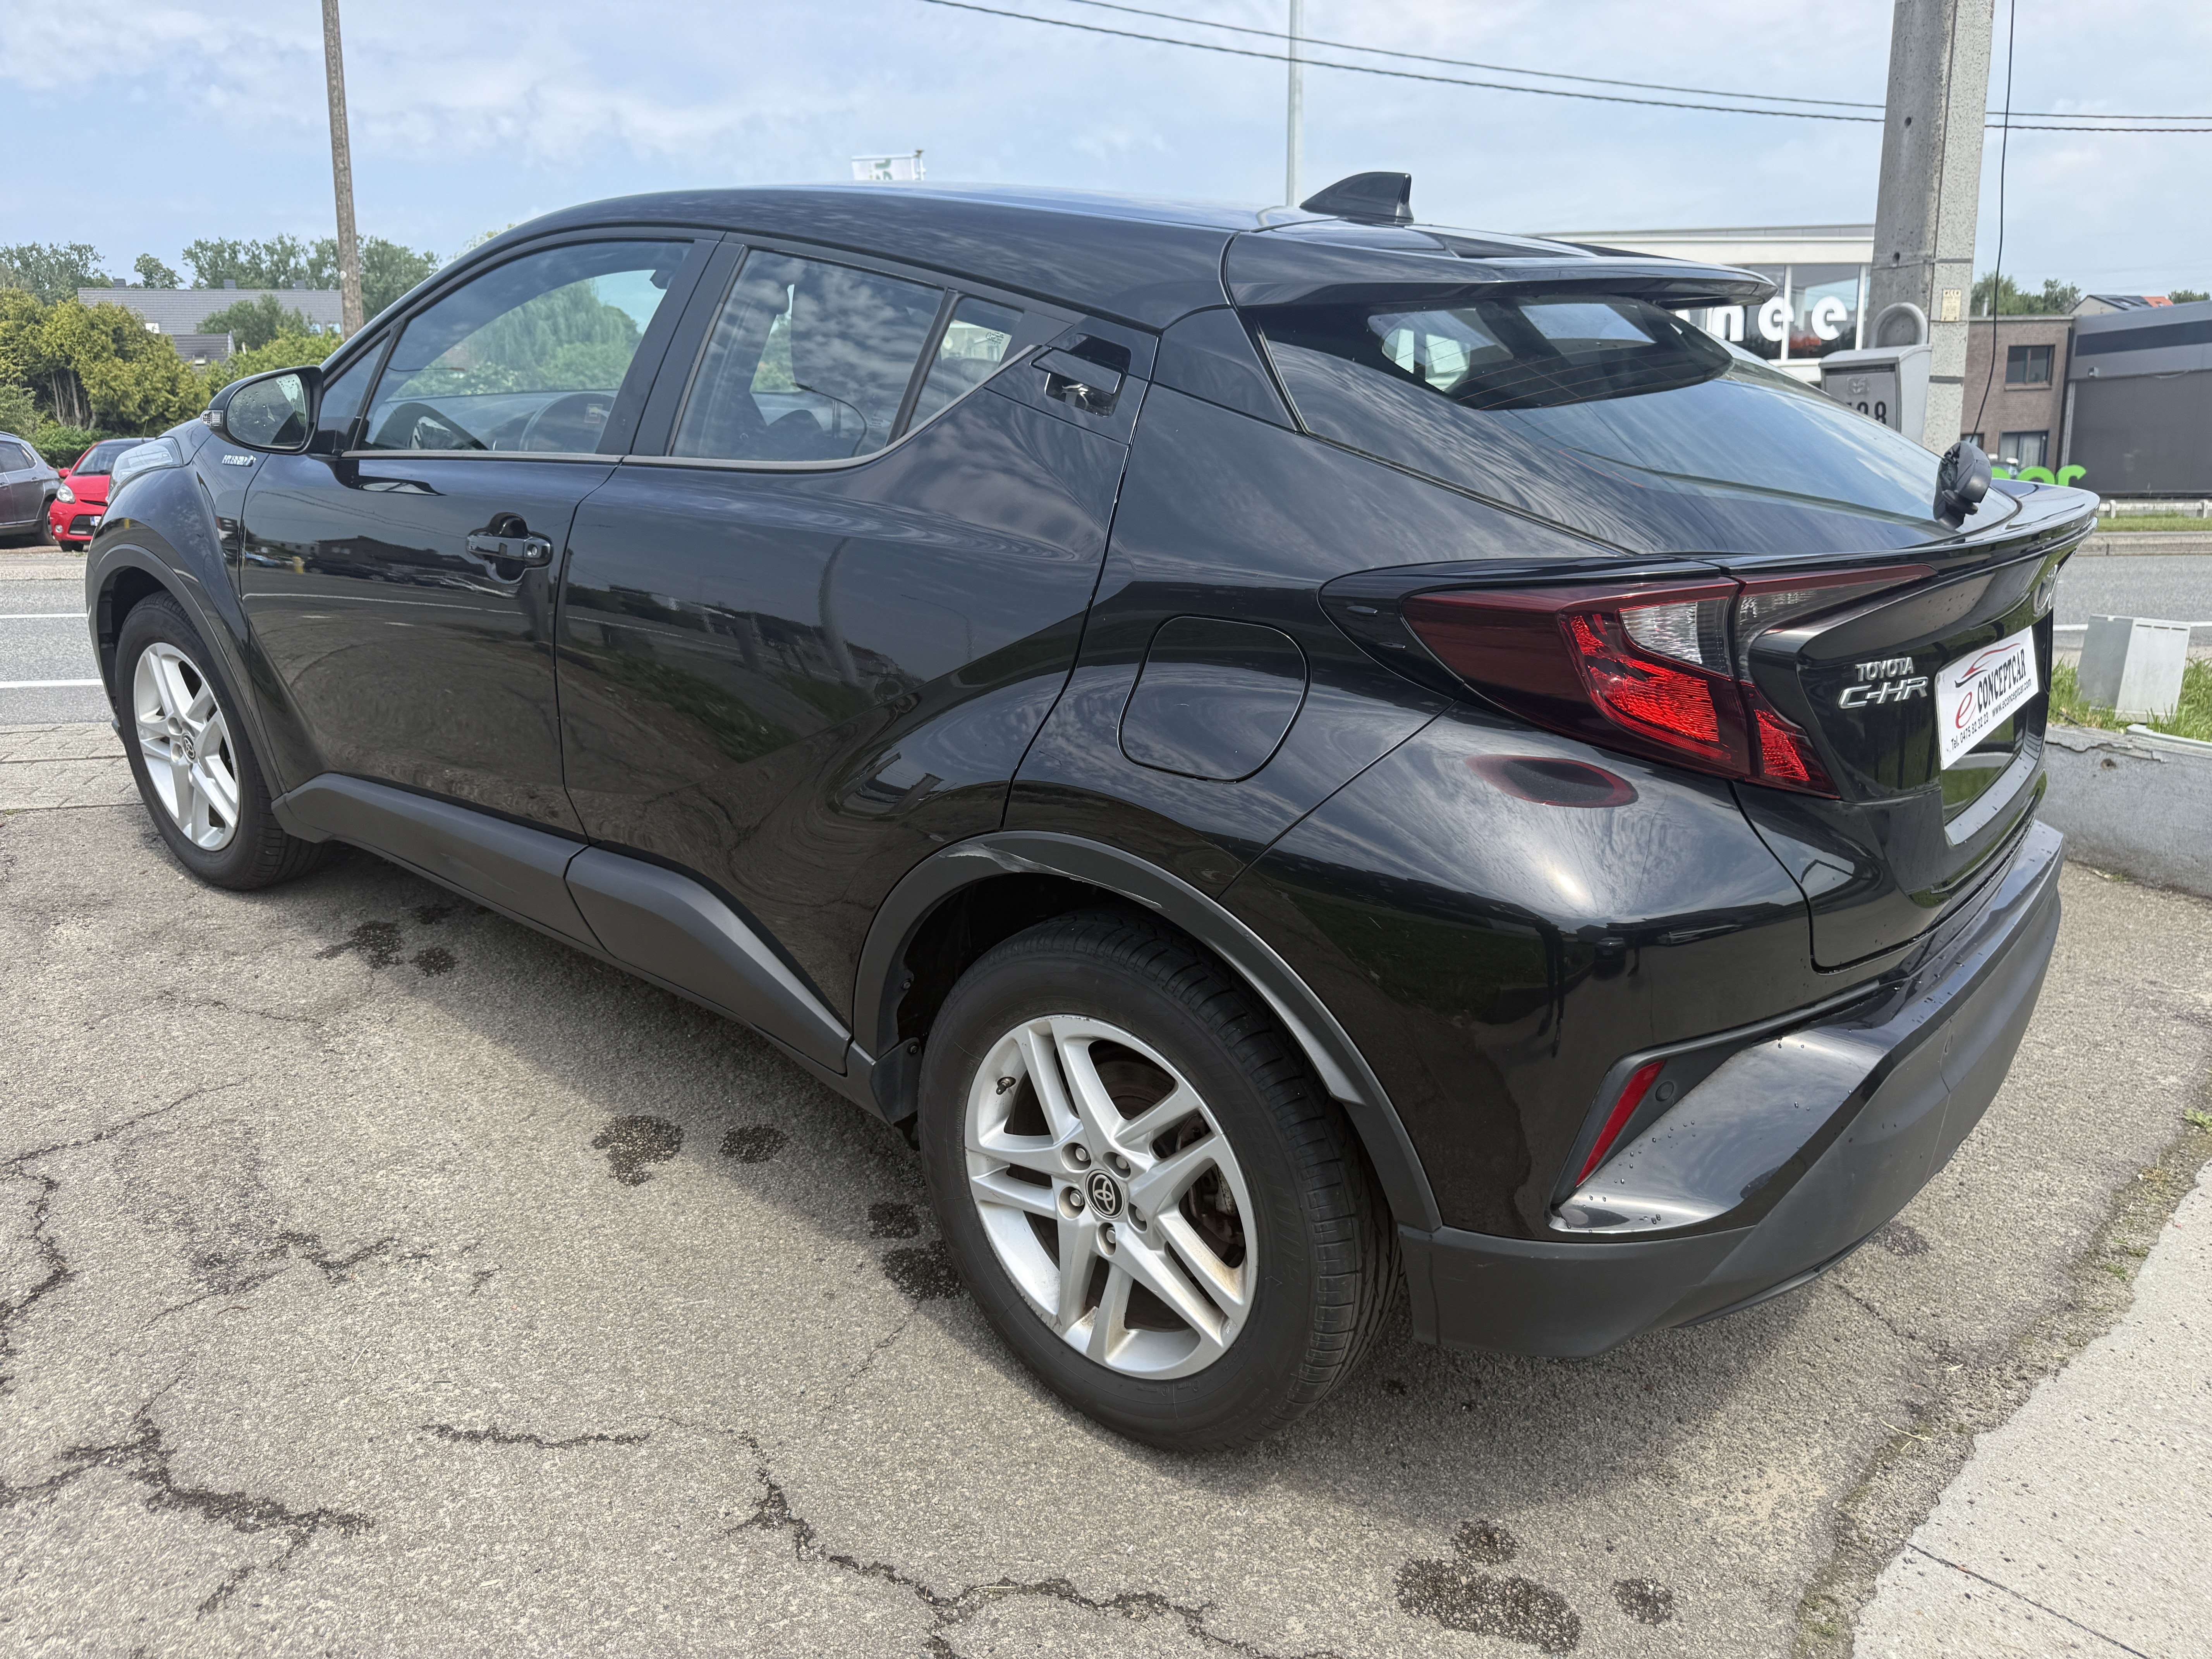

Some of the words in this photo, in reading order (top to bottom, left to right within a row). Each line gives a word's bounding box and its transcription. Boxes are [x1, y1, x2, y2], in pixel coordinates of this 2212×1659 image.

[1675, 295, 1847, 341] nee
[1838, 676, 1929, 709] C-HR
[1855, 657, 1914, 682] TOYOTA
[1977, 648, 2026, 713] CONCEPTCAR
[1951, 737, 1959, 750] Tel.
[1960, 727, 1971, 743] 0475
[1972, 722, 1977, 735] 82
[1978, 717, 1984, 730] 32
[1984, 712, 1989, 725] 23
[1992, 678, 2032, 717] www.econceptcar.com
